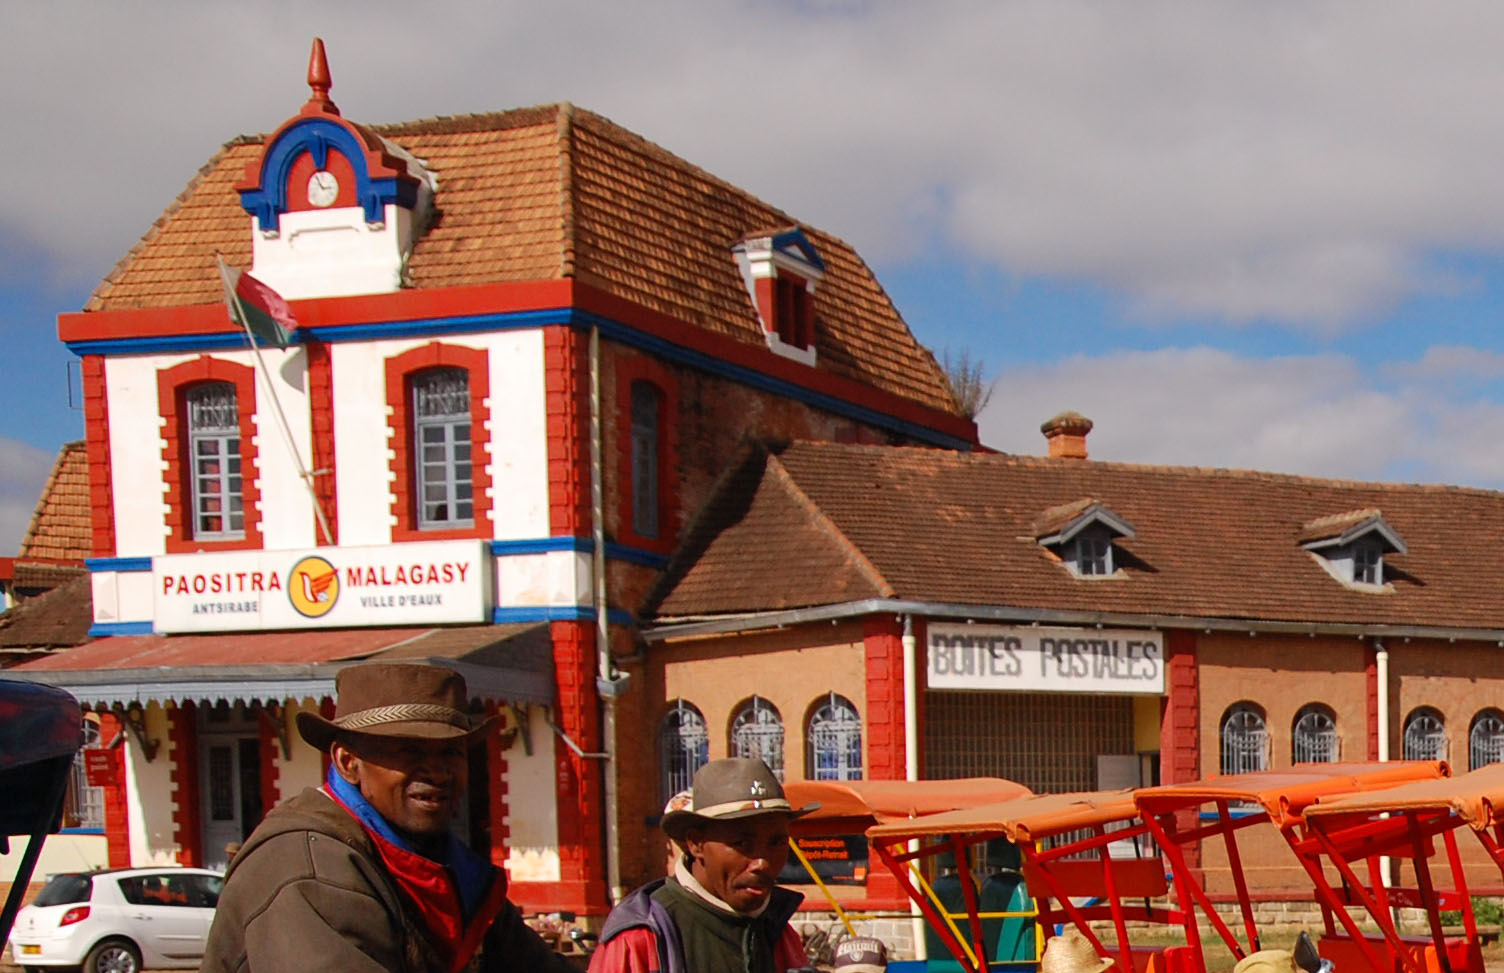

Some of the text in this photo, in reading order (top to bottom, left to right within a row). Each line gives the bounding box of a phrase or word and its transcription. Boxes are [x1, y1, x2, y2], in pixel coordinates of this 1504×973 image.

[163, 562, 470, 595] PAOSITRA MALAGASY
[192, 601, 258, 615] ANTSIRABE
[361, 594, 443, 608] VILLE D'EAUX
[931, 633, 1158, 681] BOITES POSTALES
